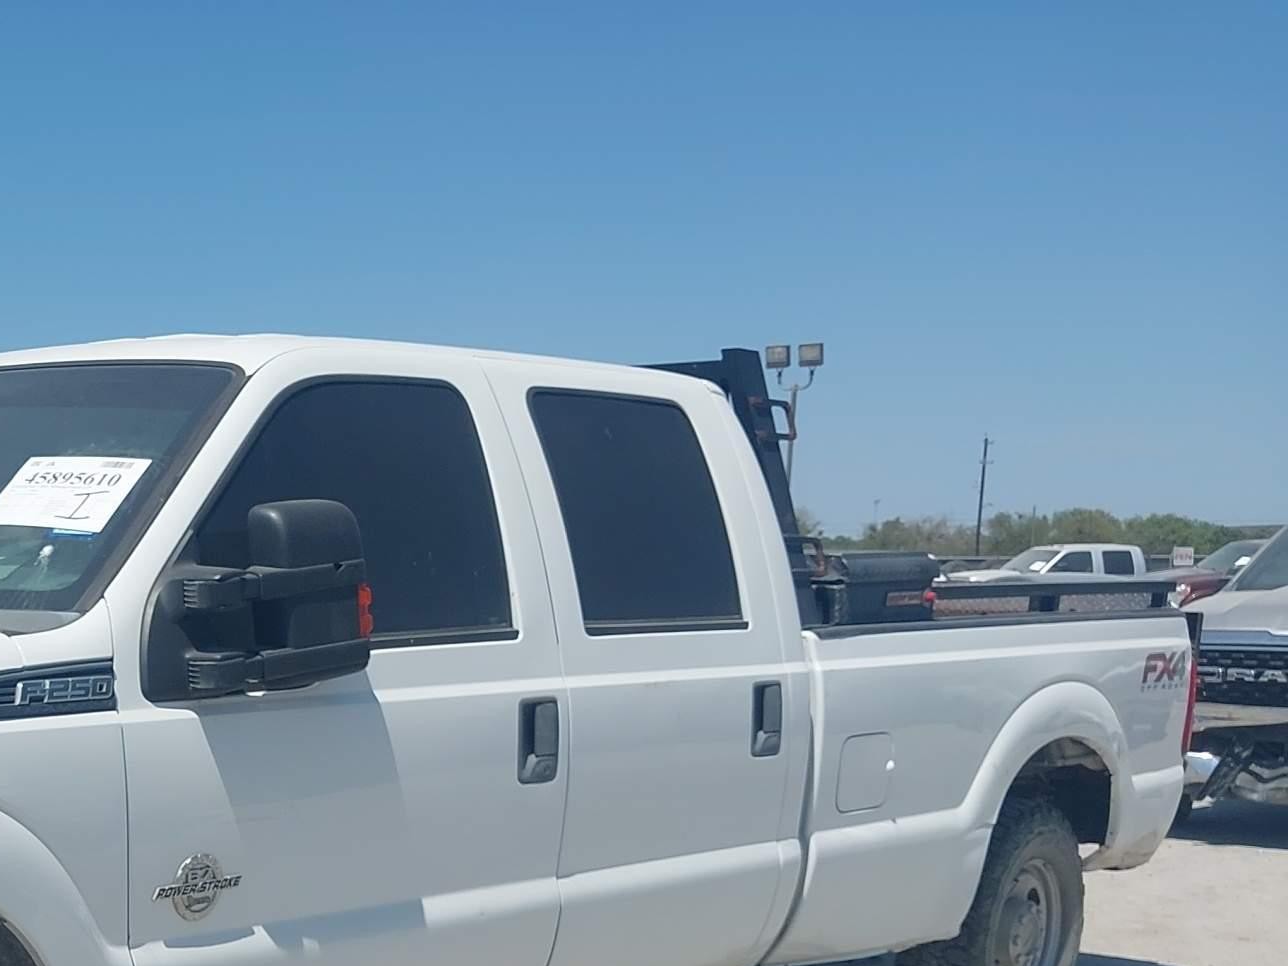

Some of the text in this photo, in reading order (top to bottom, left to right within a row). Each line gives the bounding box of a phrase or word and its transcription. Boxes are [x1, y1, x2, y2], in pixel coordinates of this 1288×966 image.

[24, 471, 122, 488] 45895610
[1141, 651, 1186, 684] FX4
[14, 675, 113, 706] F-250
